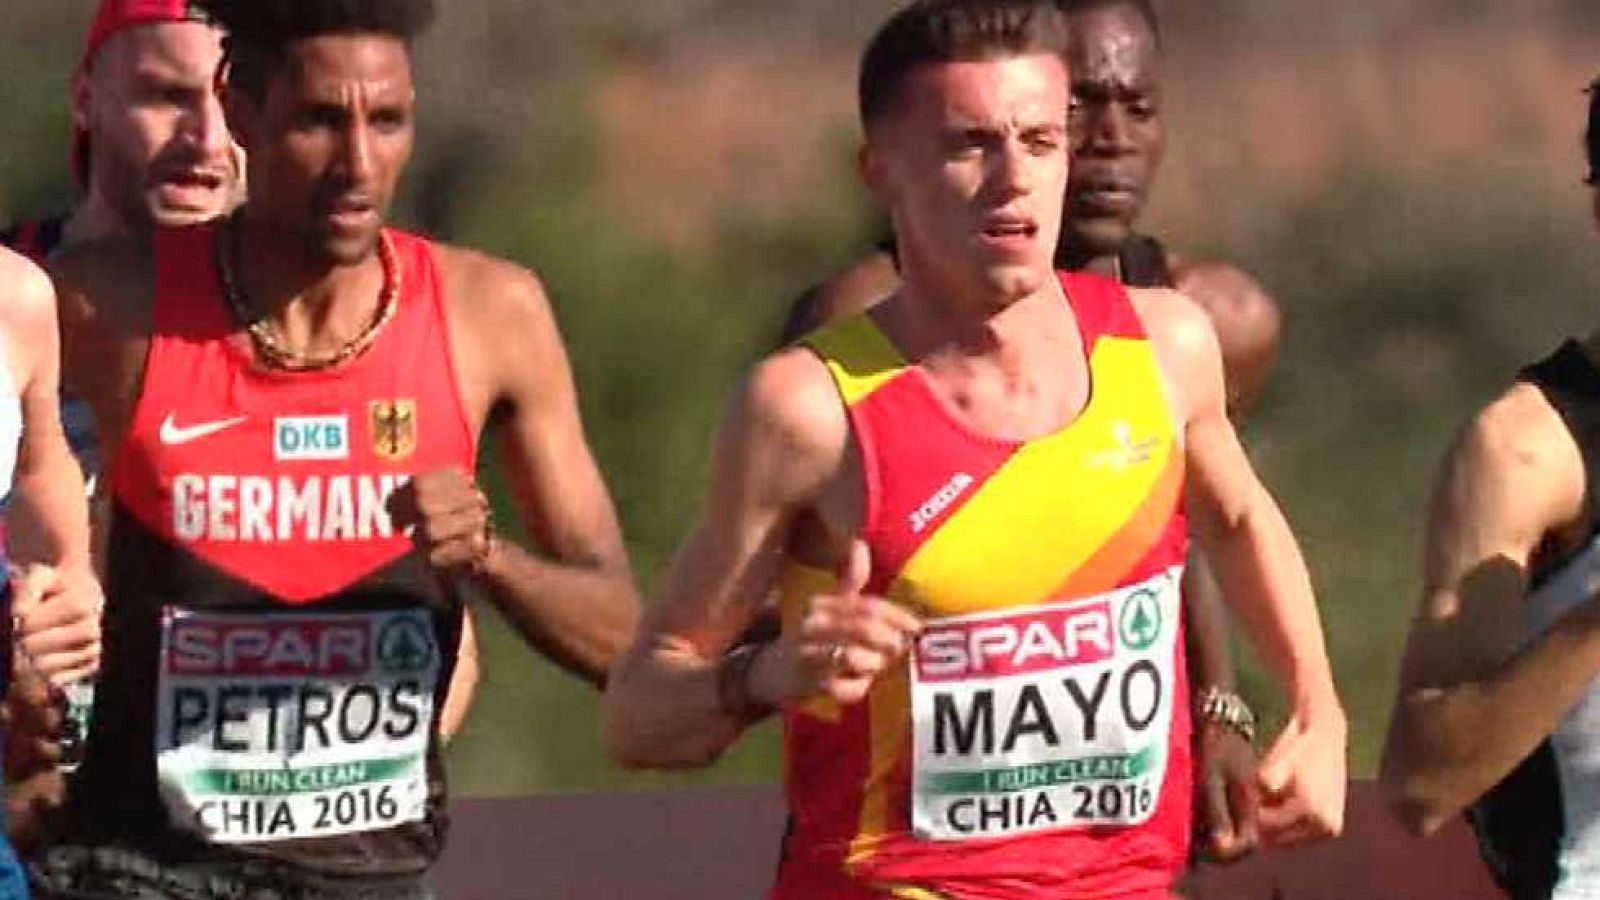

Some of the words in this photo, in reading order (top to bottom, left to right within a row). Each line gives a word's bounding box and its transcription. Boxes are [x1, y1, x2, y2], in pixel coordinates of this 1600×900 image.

[279, 423, 344, 452] DKB
[172, 474, 414, 543] GERMAN
[169, 624, 367, 672] SPAR
[920, 612, 1110, 676] SPAR
[172, 681, 419, 754] PETROS
[932, 659, 1161, 755] MAYO
[312, 786, 398, 828] 2016
[946, 791, 1056, 832] CHIA
[1072, 778, 1151, 818] 2016
